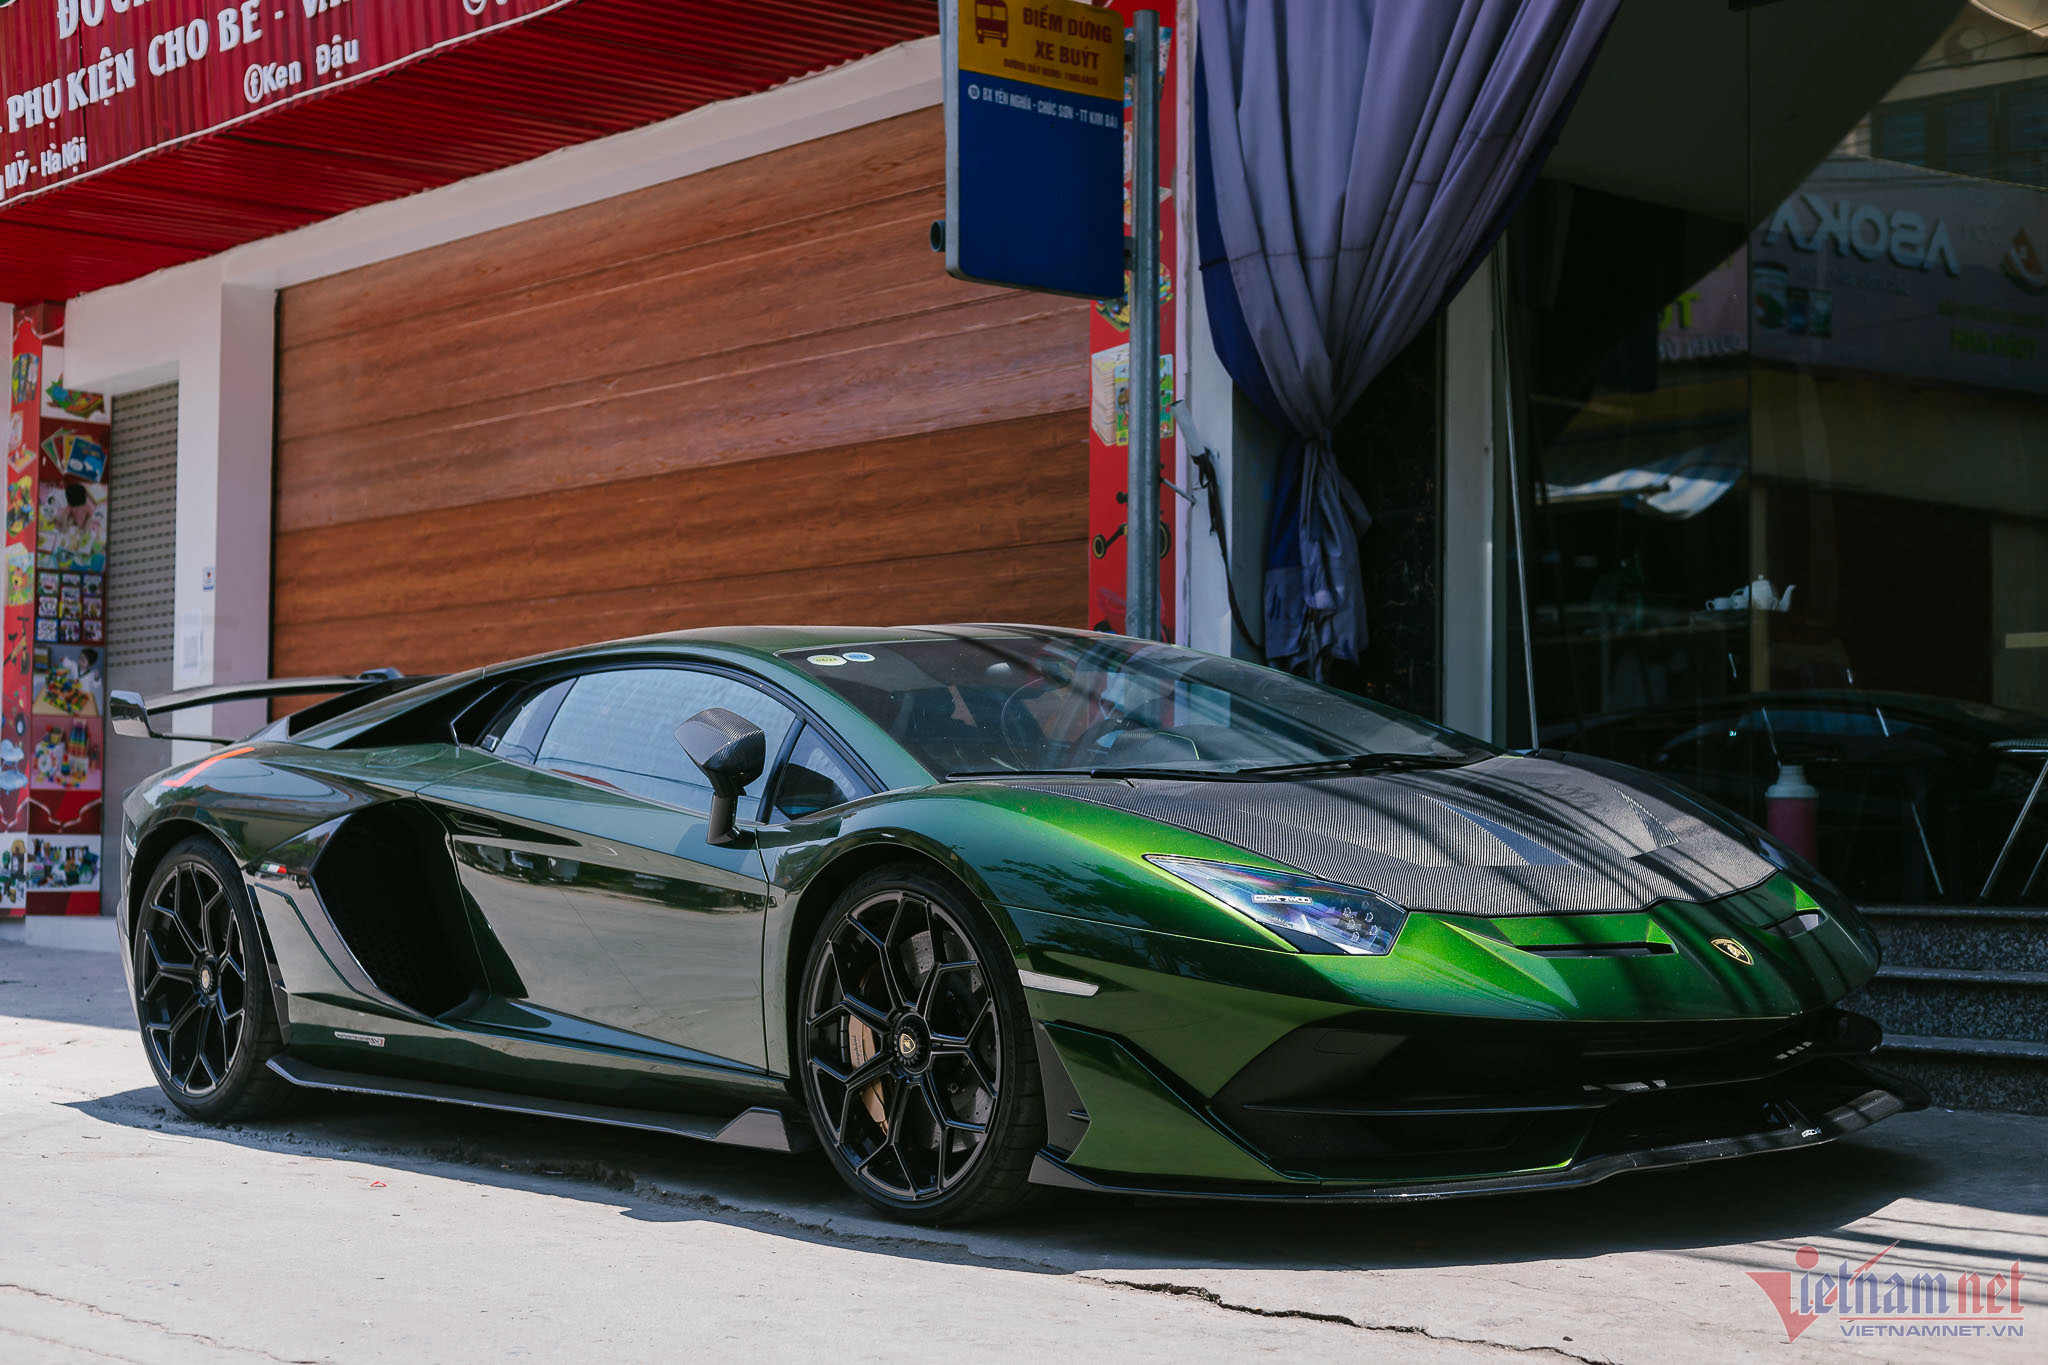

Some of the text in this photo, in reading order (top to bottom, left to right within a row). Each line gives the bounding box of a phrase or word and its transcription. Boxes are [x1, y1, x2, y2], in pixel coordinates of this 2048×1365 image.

[7, 79, 62, 133] PHỤ
[67, 46, 136, 111] KIỆN
[148, 18, 209, 76] CHO
[262, 61, 302, 95] Ken
[316, 34, 359, 78] Đậu
[1034, 40, 1099, 70] XE BUÝT
